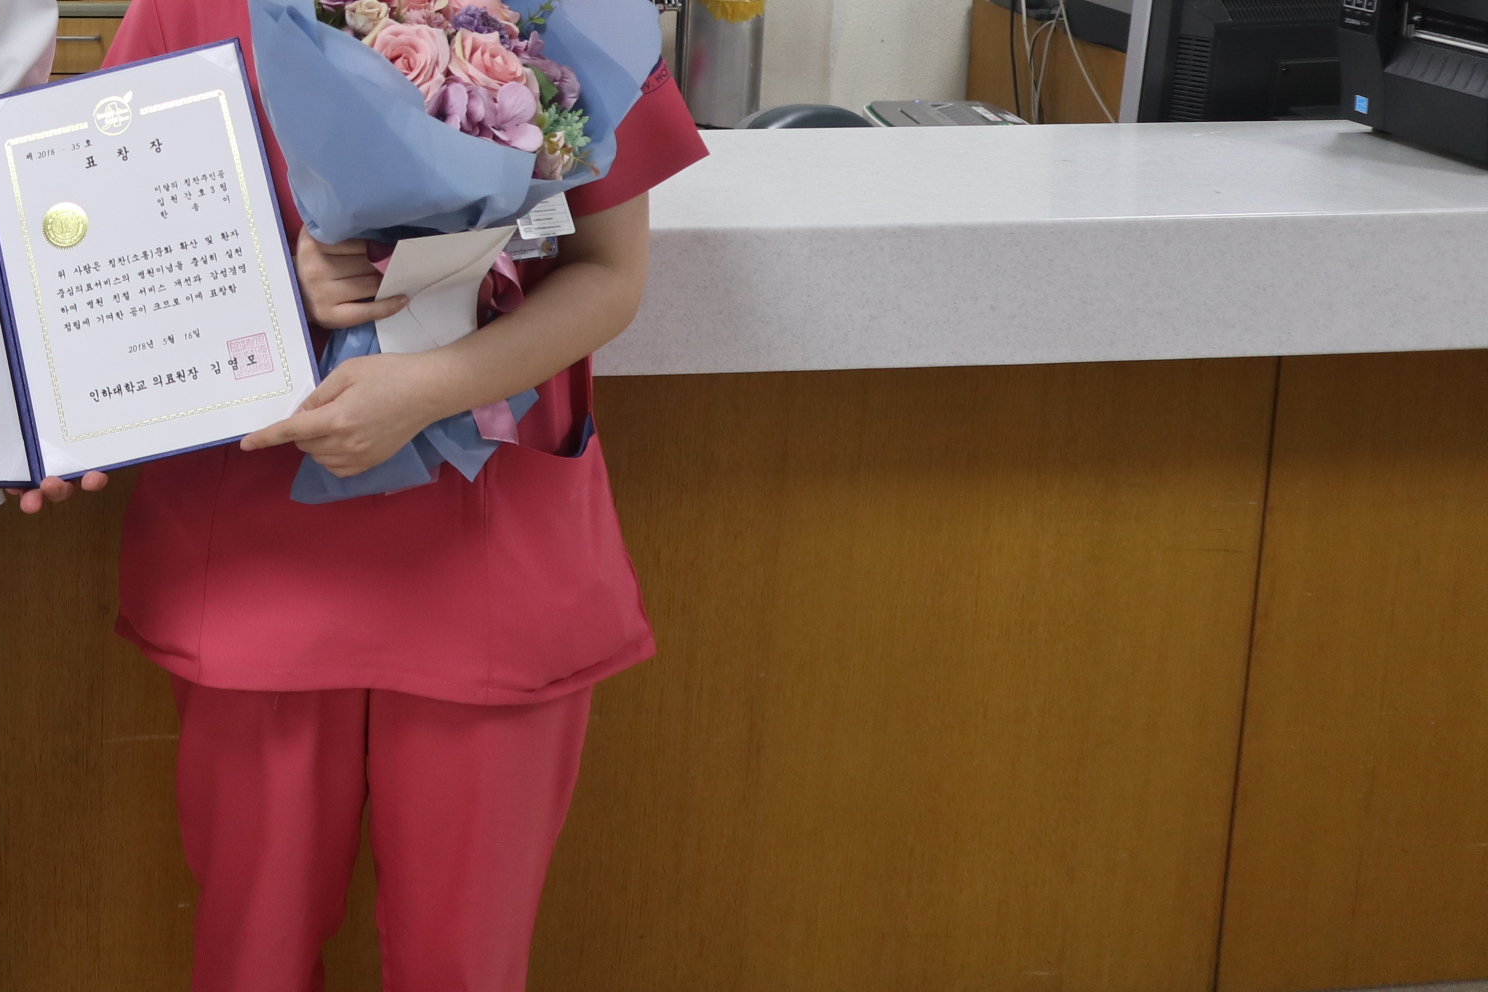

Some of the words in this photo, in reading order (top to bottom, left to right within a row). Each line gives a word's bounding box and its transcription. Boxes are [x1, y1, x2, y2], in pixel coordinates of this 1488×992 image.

[37, 147, 56, 160] 2018
[71, 142, 81, 151] 35
[154, 180, 179, 194] 이달의
[183, 169, 226, 187] 칭찬주인공
[57, 269, 66, 280] 위
[73, 261, 102, 276] 사람은
[179, 238, 199, 251] 확산
[204, 235, 214, 246] 및
[220, 228, 240, 242] 환자
[224, 246, 244, 260] 실천
[60, 301, 79, 315] 하여
[86, 296, 104, 310] 병원
[138, 283, 167, 297] 서비스
[173, 273, 203, 288] 개선과
[96, 309, 125, 325] 기여한
[129, 303, 147, 318] 공이
[152, 297, 181, 311] 크므로
[185, 290, 204, 304] 이에
[209, 283, 238, 299] 표창함
[128, 340, 155, 354] 2018년
[162, 334, 176, 346] 5월
[183, 328, 201, 341] 16일
[89, 379, 148, 403] 인하대학교
[152, 366, 200, 387] 의료원장
